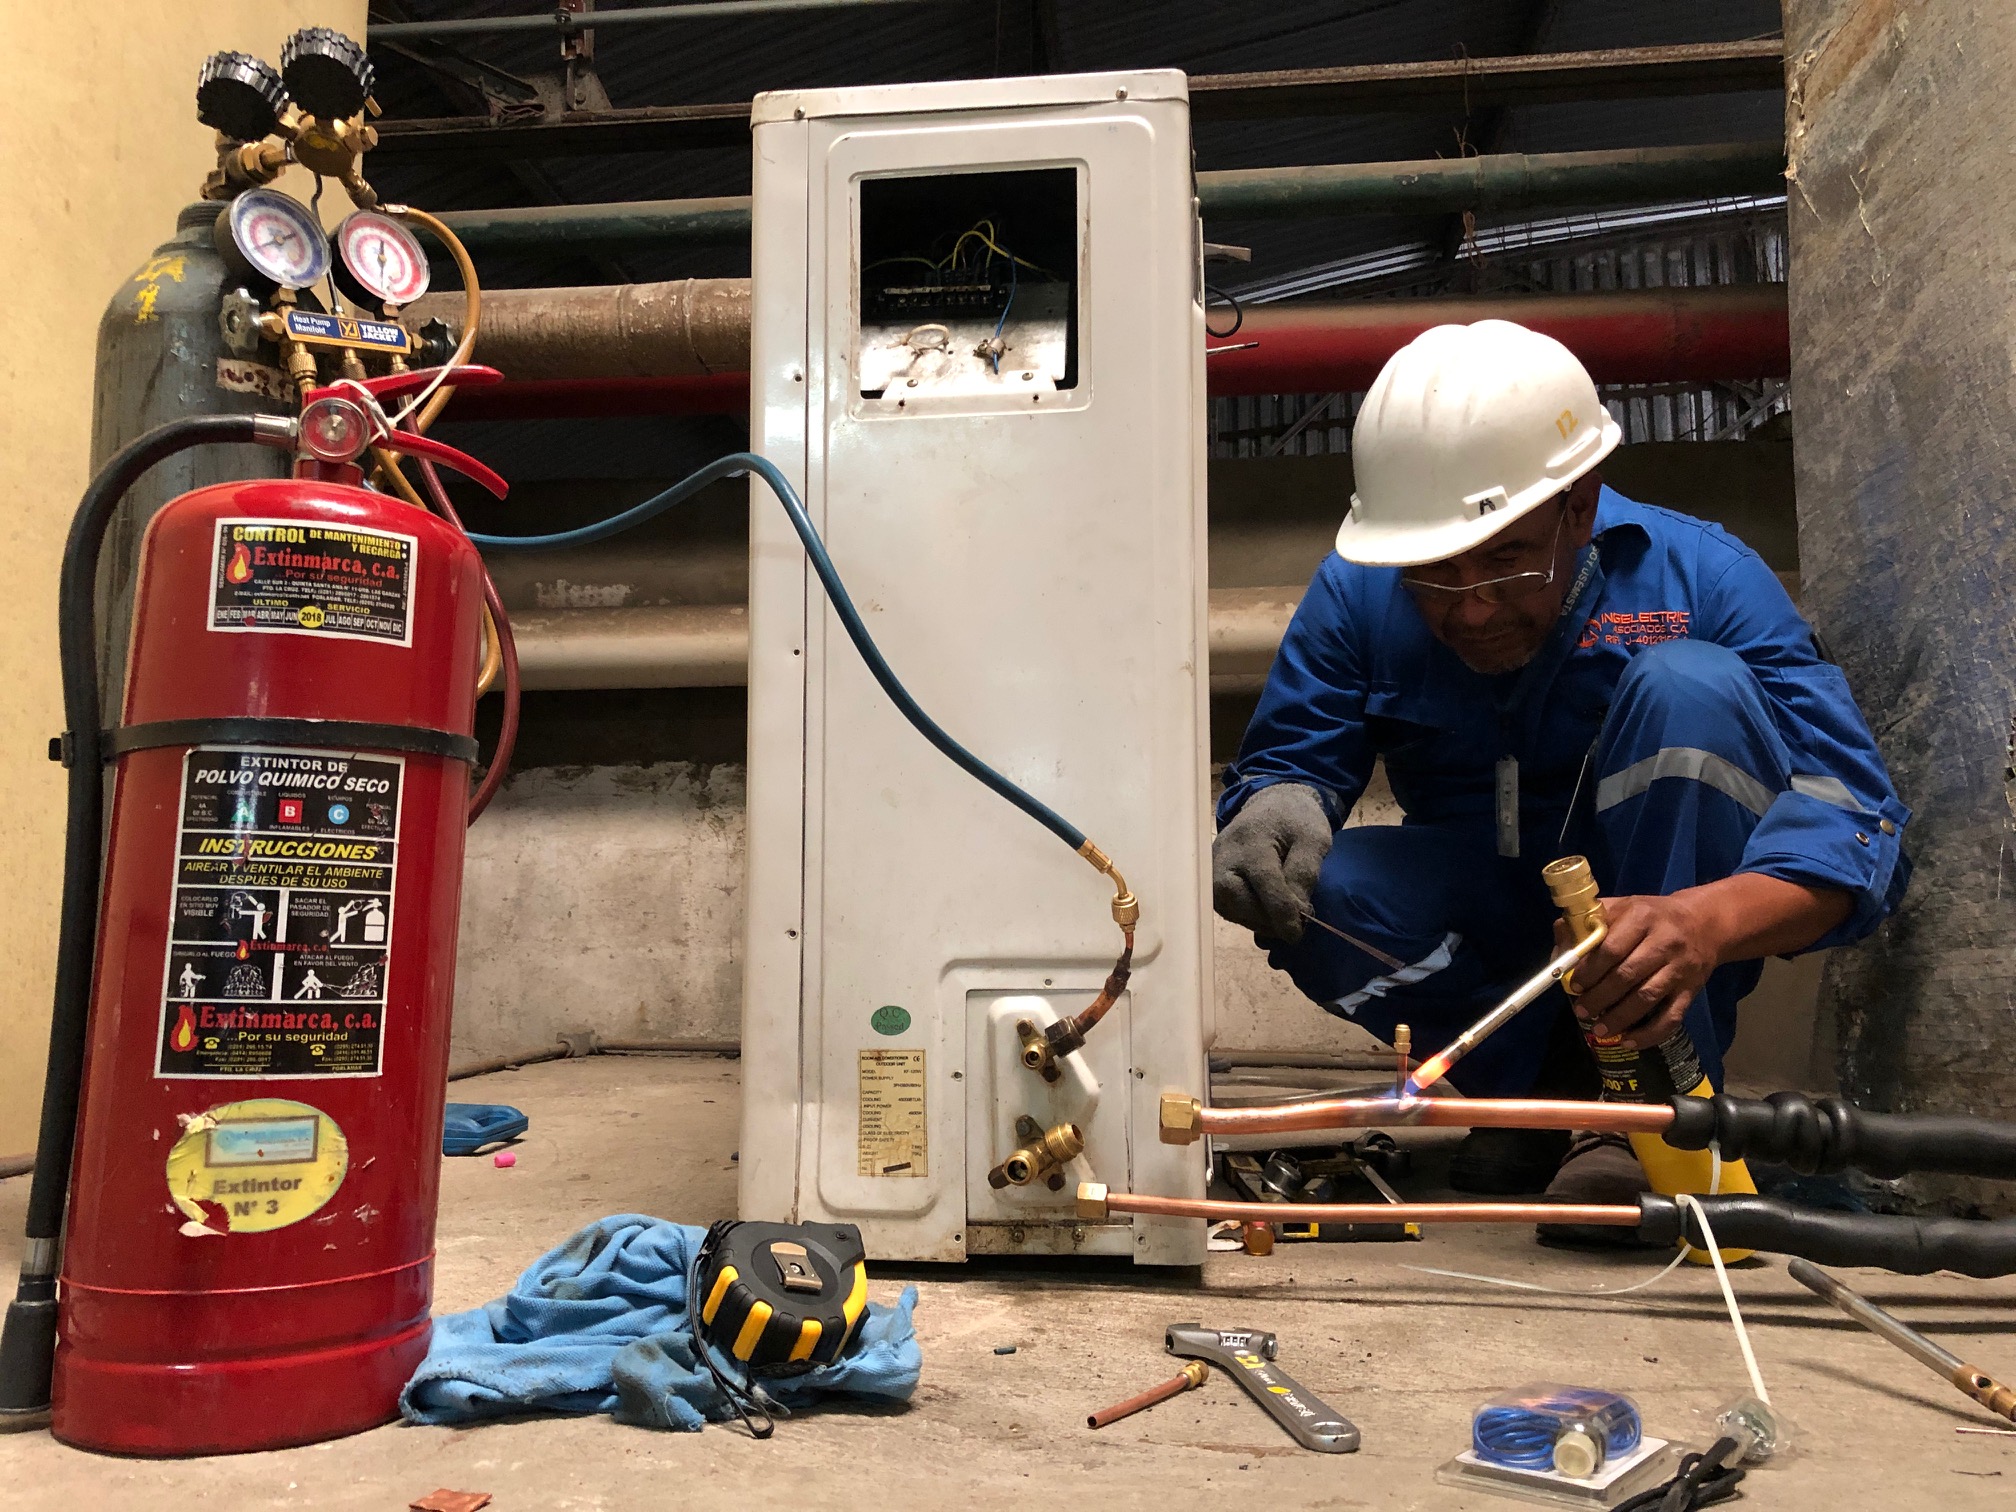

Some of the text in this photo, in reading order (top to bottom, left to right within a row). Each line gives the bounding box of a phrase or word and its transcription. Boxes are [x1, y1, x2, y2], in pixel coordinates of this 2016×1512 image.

[293, 314, 331, 327] Heat Pump
[295, 324, 326, 334] Manifold
[360, 324, 398, 335] YELLOW
[362, 332, 397, 342] JACKET
[233, 526, 401, 550] CONTROL DE MANTENIMIENTO
[352, 543, 401, 559] Y RECARGA
[254, 546, 400, 579] Extinmarca, c.a.
[310, 571, 324, 580] su
[327, 573, 383, 588] seguridad
[252, 599, 288, 607] ULTIMO
[327, 603, 370, 615] SERVICIO
[217, 607, 228, 619] ENE
[229, 607, 241, 619] FEB
[256, 608, 269, 619] ABR
[270, 608, 283, 620] MAY
[285, 609, 298, 621] JUN
[301, 611, 321, 622] 2018
[325, 612, 336, 624] JUL
[338, 613, 351, 625] AGO
[353, 615, 364, 627] SEP
[366, 617, 378, 628] OCT
[379, 618, 391, 629] NOV
[393, 620, 402, 632] DIC
[1601, 611, 1690, 624] INGELECTRIC
[1613, 624, 1666, 634] ASOCIADOS
[240, 756, 348, 772] EXTINTOR DE
[195, 769, 390, 794] POLVO QUIMICO SECO
[240, 806, 249, 817] A
[284, 806, 295, 817] B
[333, 808, 344, 819] C
[269, 824, 310, 832] INFLAMABLES
[320, 827, 356, 835] ELECTRICOS
[198, 838, 379, 860] INSTRUCCIONES
[184, 862, 383, 879] AIREAR Y VENTILAR EL AMBIENTE
[219, 875, 348, 888] DESPUES DE SU USO
[184, 909, 214, 917] VISIBLE
[200, 1005, 377, 1031] Extinmarca, c.a.
[265, 1033, 282, 1041] su
[285, 1031, 348, 1043] seguridad
[1628, 1079, 1638, 1091] F
[213, 1177, 303, 1195] Extintor
[233, 1200, 279, 1217] N° 3
